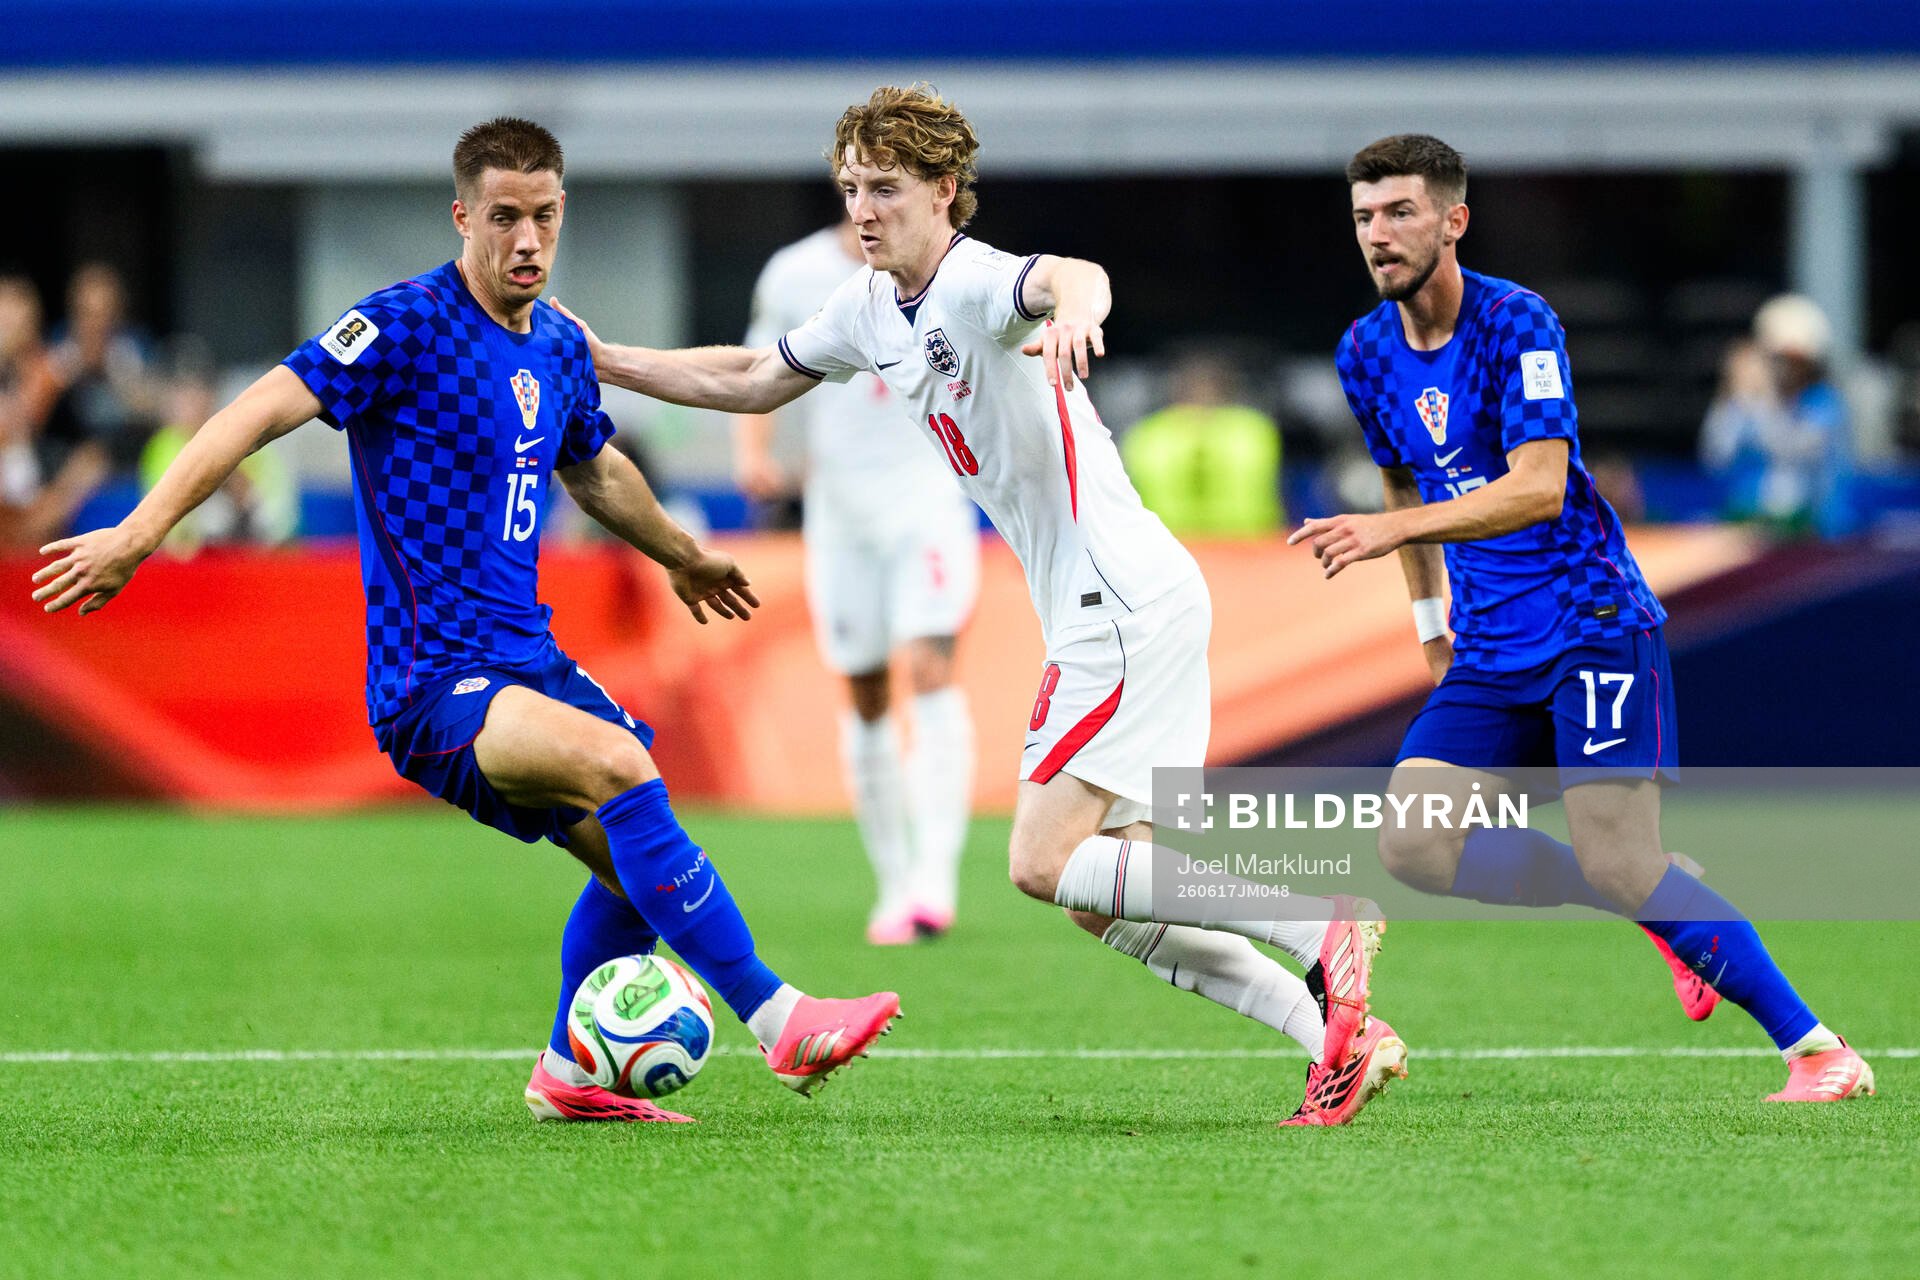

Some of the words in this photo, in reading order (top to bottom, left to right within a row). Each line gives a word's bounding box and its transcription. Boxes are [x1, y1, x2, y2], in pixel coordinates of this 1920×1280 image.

[928, 412, 979, 477] 18
[503, 473, 539, 542] 15
[1579, 670, 1635, 729] 17
[673, 851, 705, 888] HNS
[1693, 951, 1713, 968] NS
